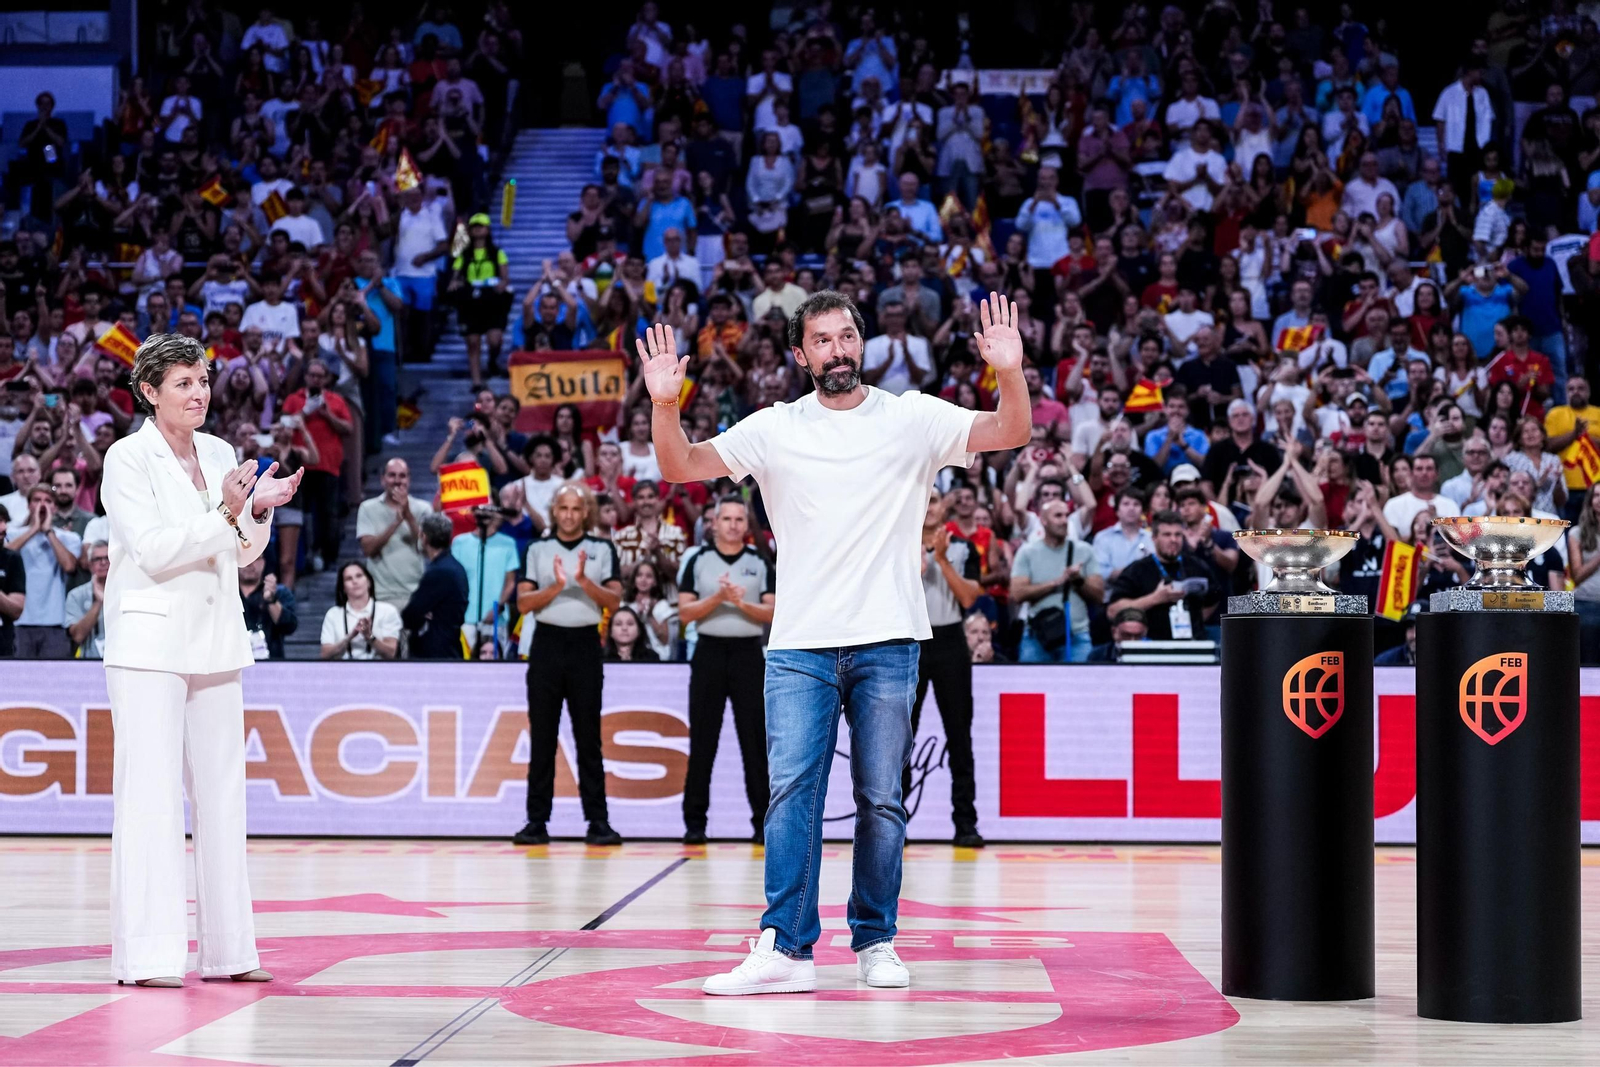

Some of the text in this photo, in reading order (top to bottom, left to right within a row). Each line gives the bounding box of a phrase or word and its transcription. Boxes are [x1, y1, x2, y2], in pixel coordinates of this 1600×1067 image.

[523, 364, 620, 400] Ávila
[223, 508, 236, 523] VIP
[1320, 656, 1340, 666] FEB
[1500, 657, 1523, 668] FEB
